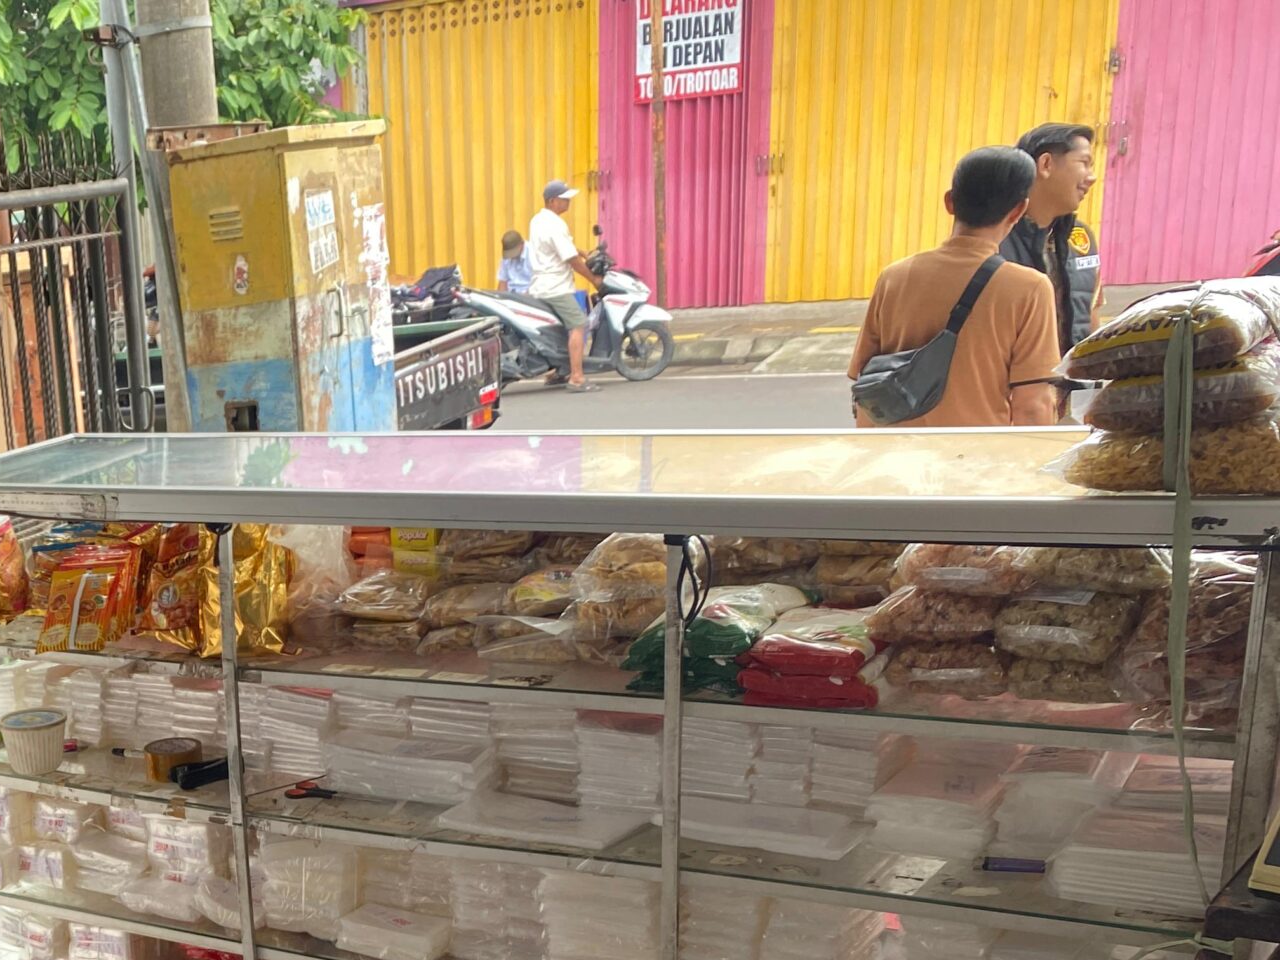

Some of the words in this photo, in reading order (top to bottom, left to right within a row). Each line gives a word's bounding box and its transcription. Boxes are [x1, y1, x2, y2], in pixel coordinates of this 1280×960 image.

[642, 11, 735, 45] BRJUALAN
[672, 39, 725, 67] DEPAN
[638, 67, 738, 99] TOO/TROTOAR
[398, 346, 483, 408] ITSUBISHI
[398, 528, 429, 543] Popular
